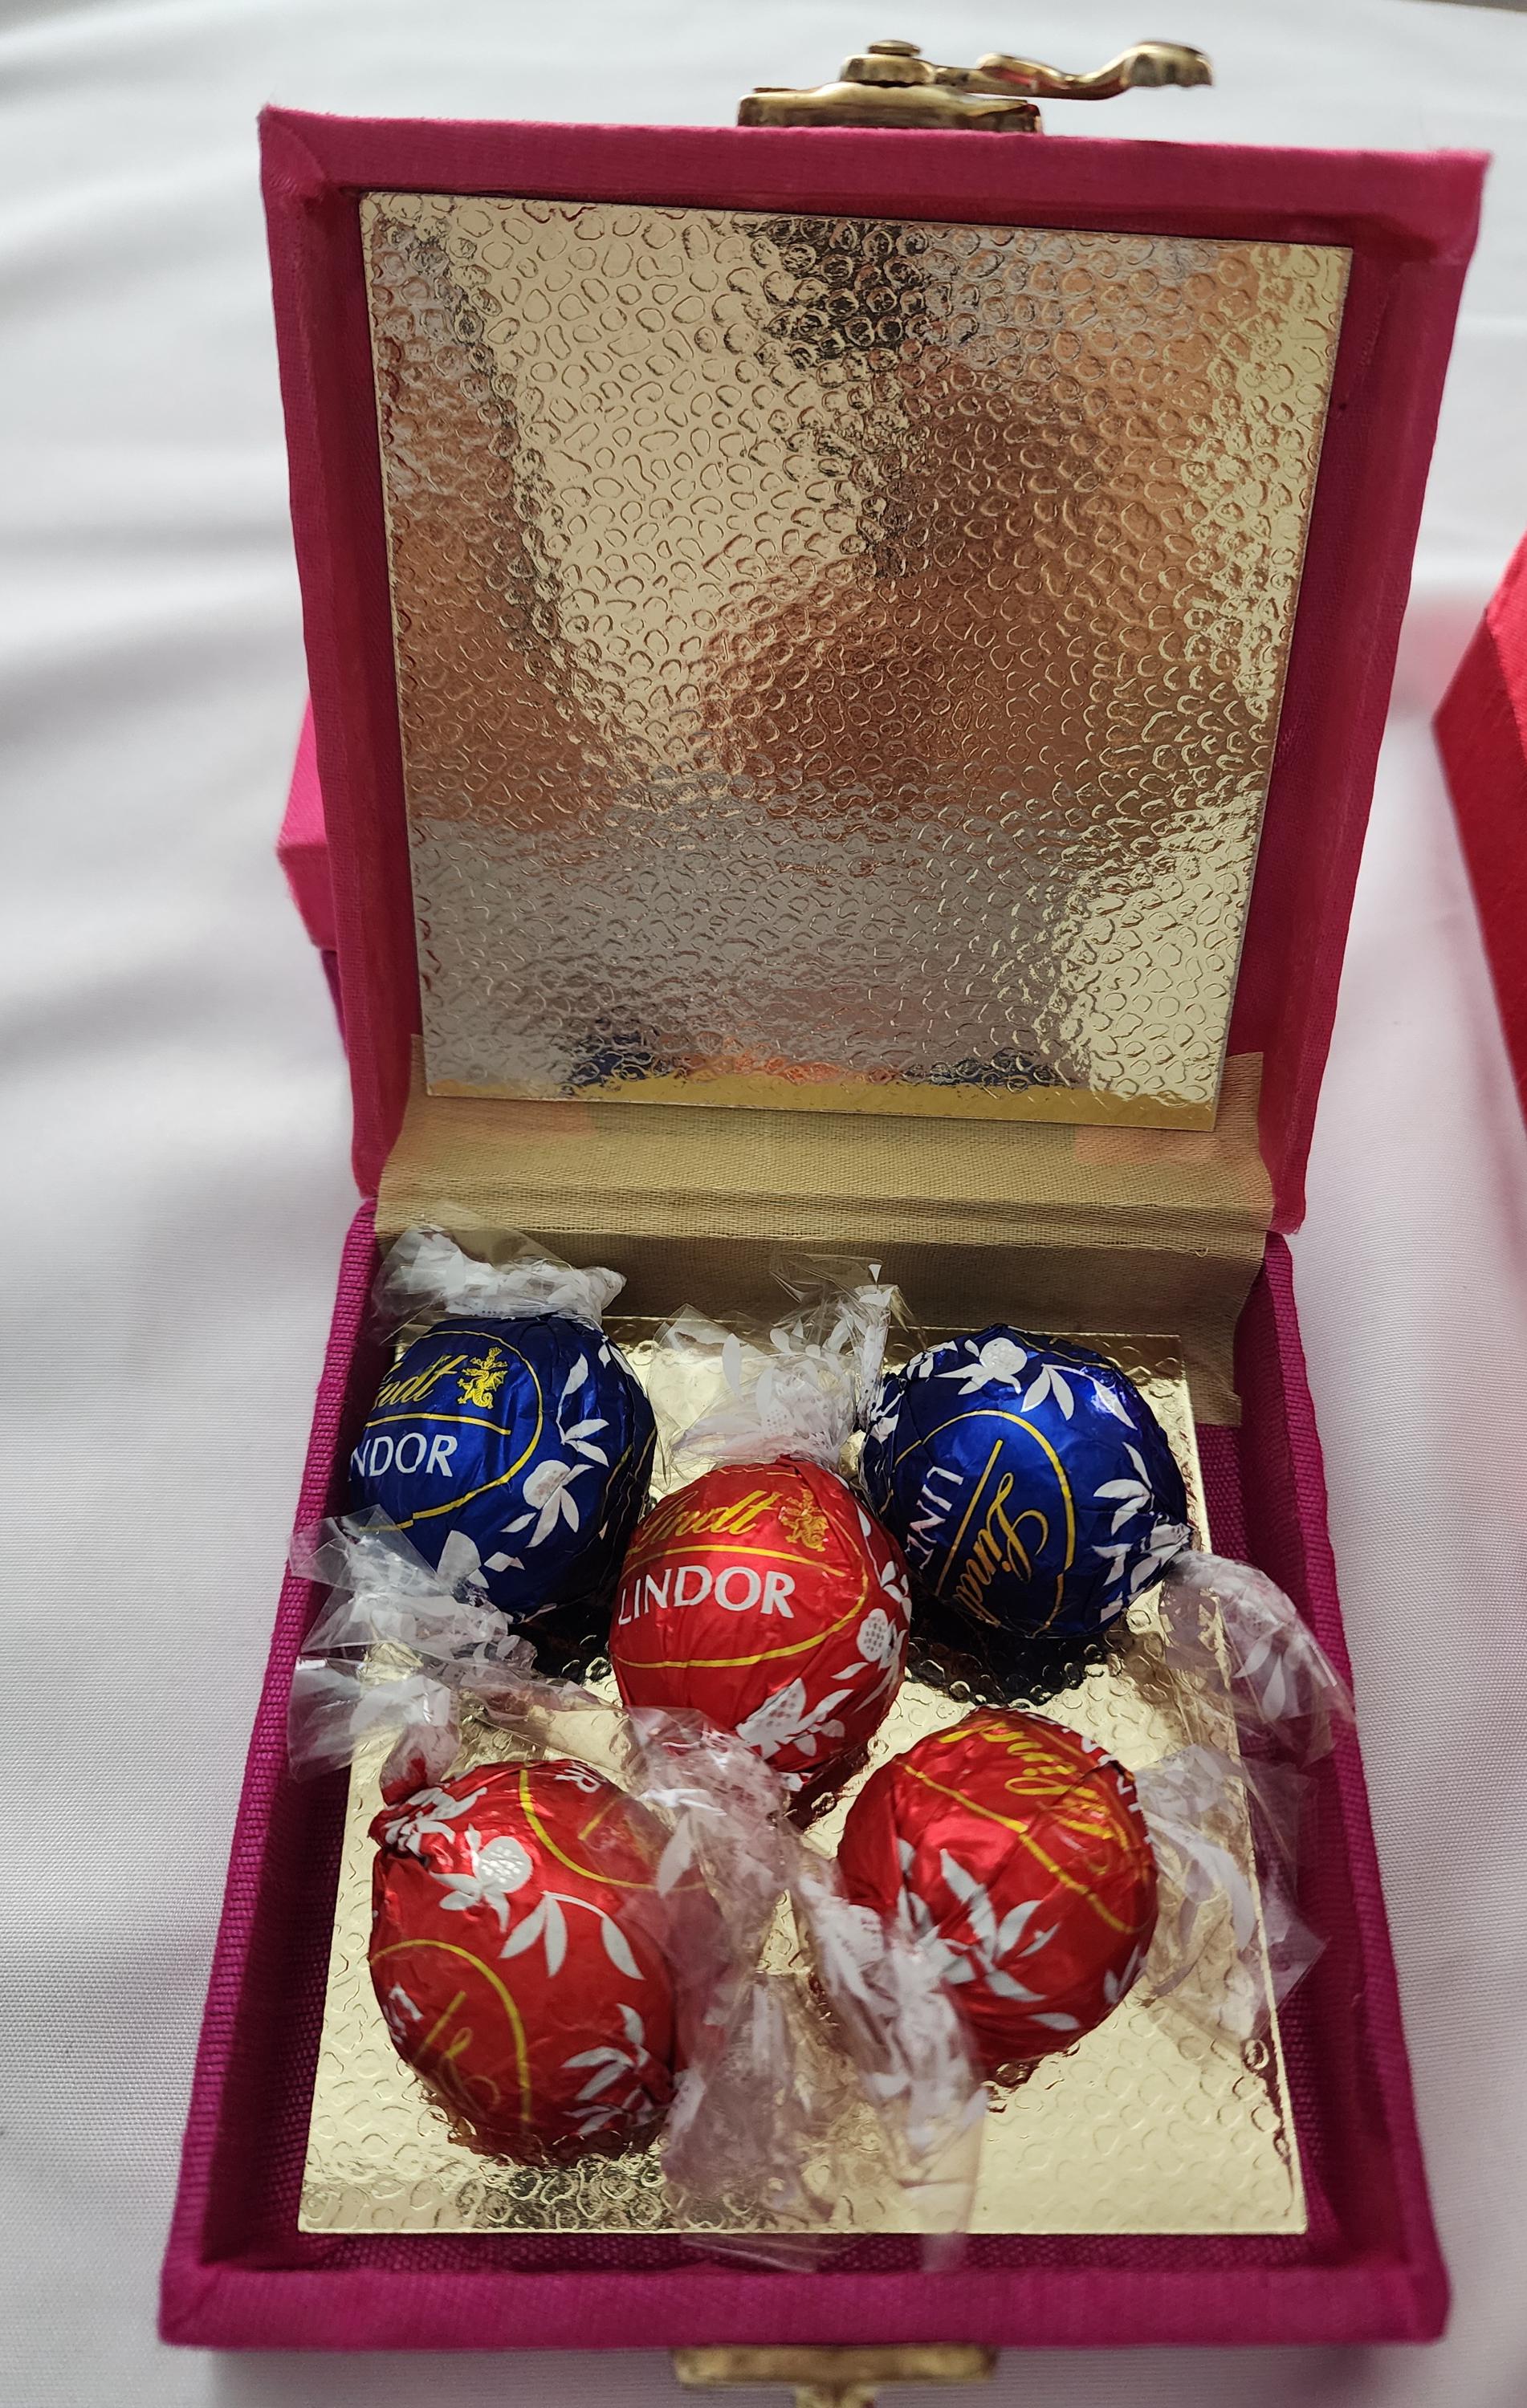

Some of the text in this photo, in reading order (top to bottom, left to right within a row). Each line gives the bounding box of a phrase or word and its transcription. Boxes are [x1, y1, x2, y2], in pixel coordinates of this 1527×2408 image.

[371, 1355, 469, 1413] ndt
[348, 1433, 458, 1482] NDOR
[618, 1565, 795, 1625] LINDOR
